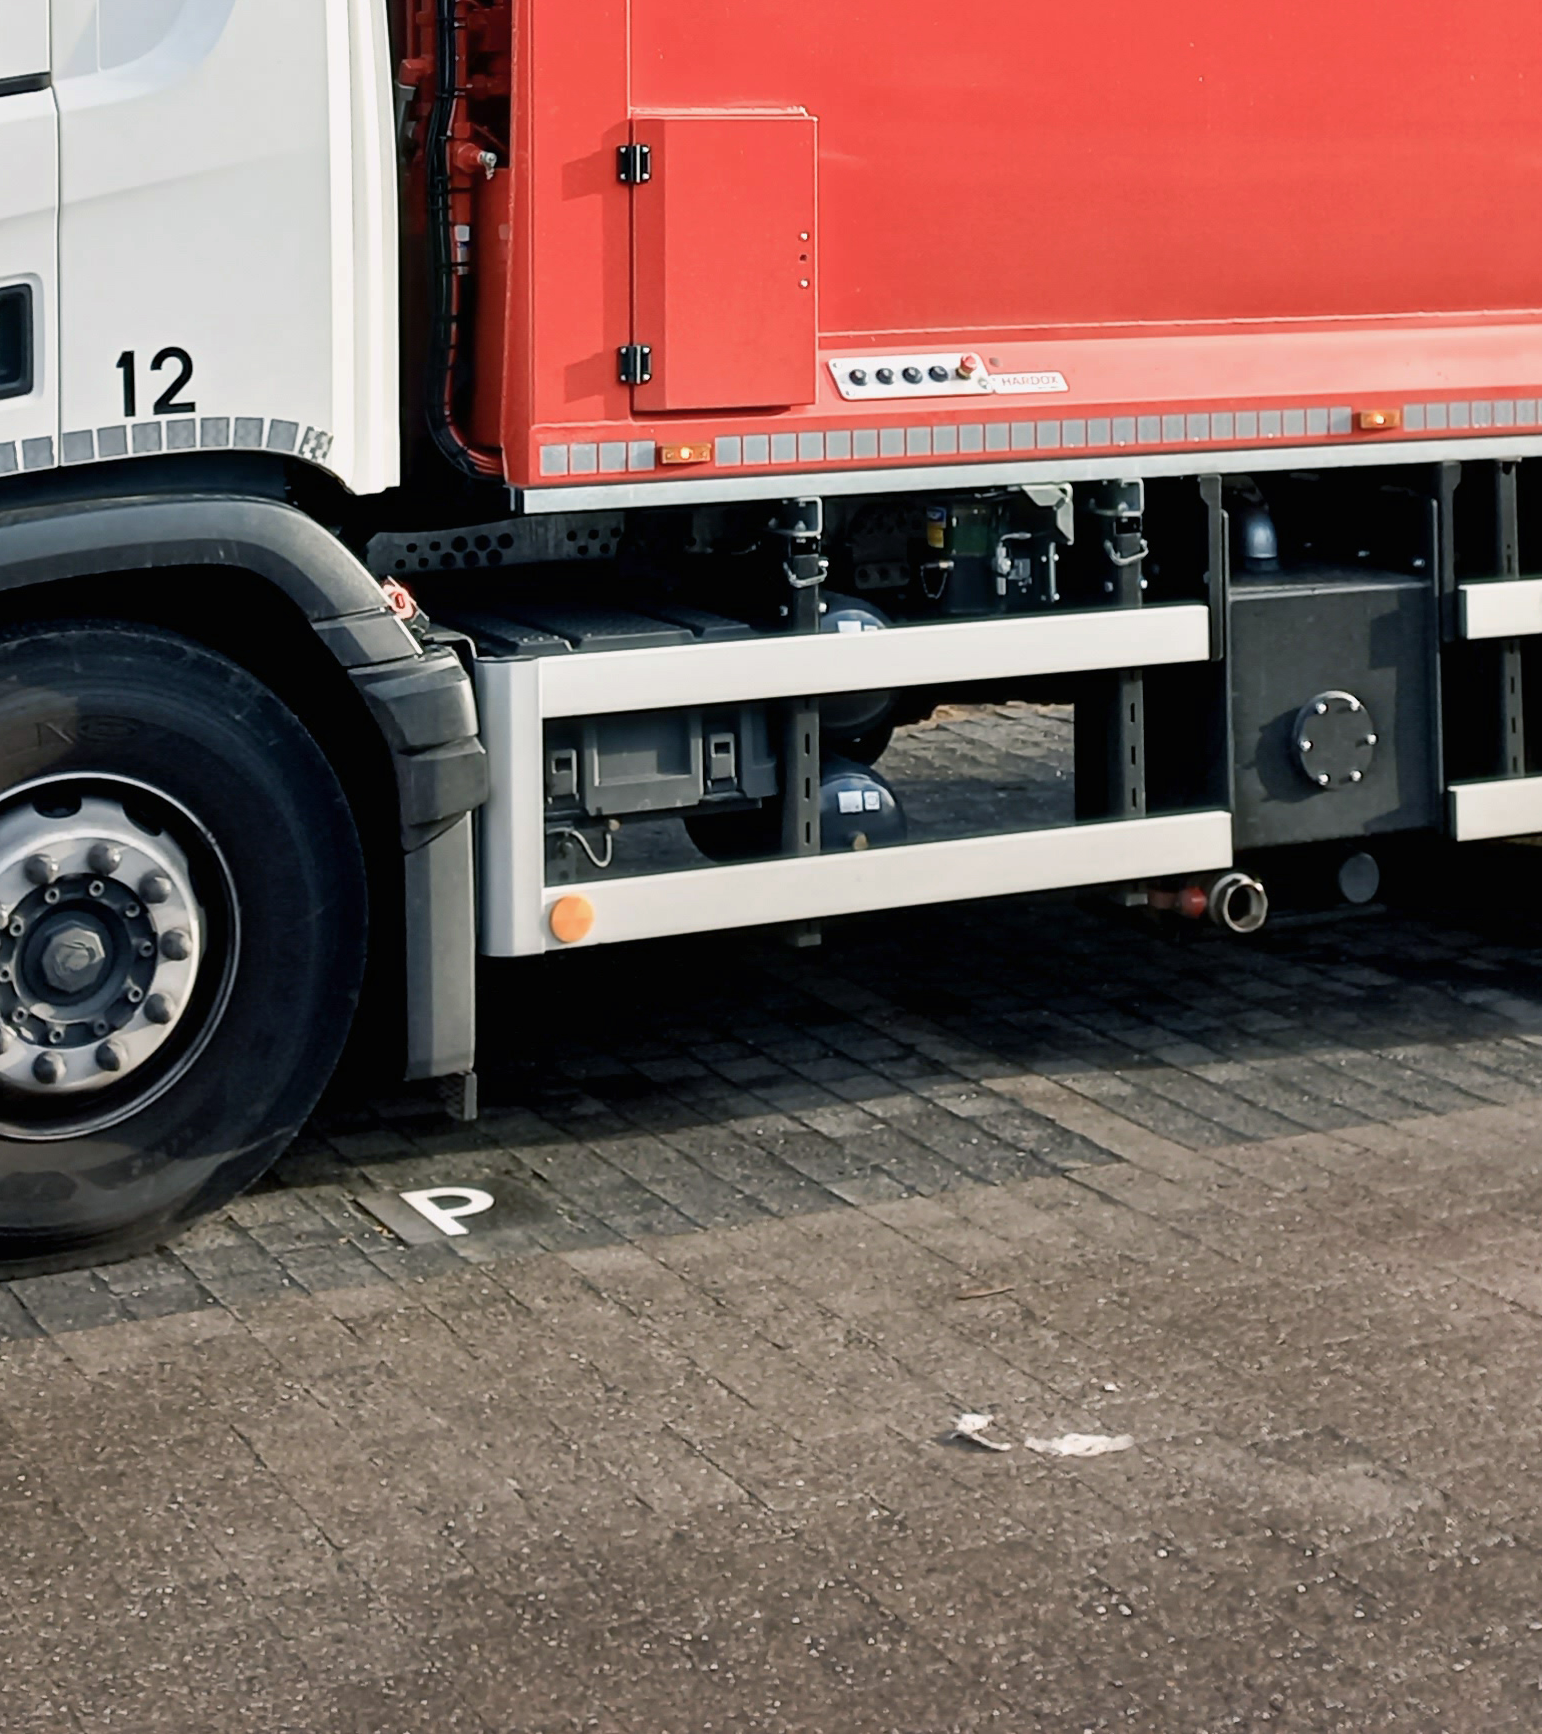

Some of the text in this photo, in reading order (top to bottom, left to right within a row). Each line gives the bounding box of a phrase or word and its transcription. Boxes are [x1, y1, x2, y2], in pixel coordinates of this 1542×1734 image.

[115, 346, 196, 417] 12
[1001, 375, 1059, 386] HARDOX
[399, 1186, 495, 1236] P
